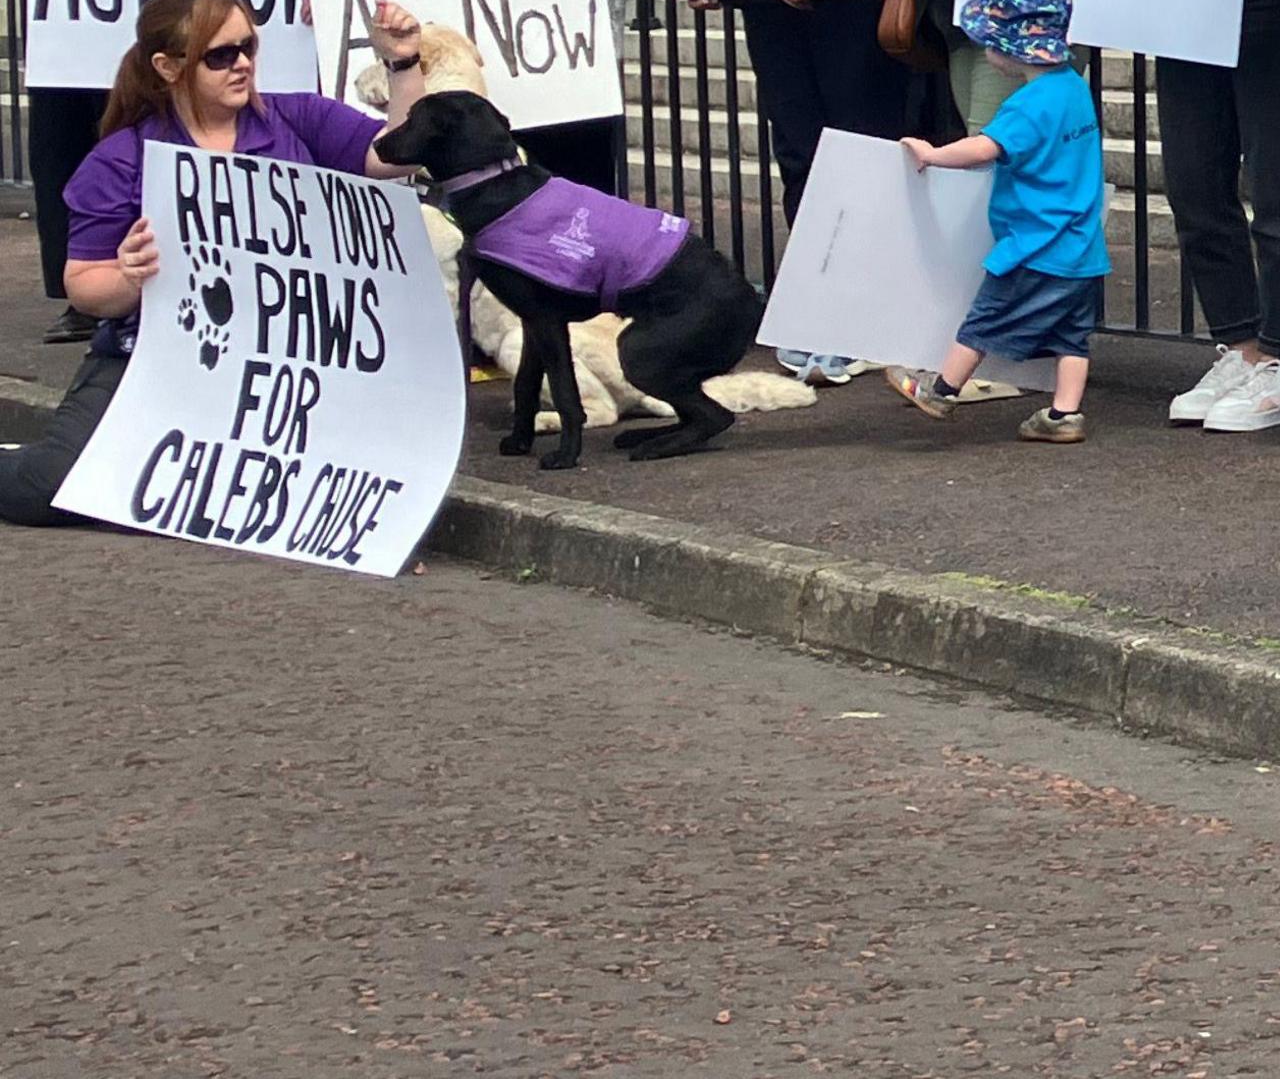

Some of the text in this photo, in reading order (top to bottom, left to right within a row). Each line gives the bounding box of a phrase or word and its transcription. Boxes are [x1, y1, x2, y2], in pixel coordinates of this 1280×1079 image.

[176, 151, 407, 276] RAISE YOUR
[255, 263, 386, 373] PAWS
[230, 360, 320, 455] FOR
[287, 463, 403, 566] CAUSE
